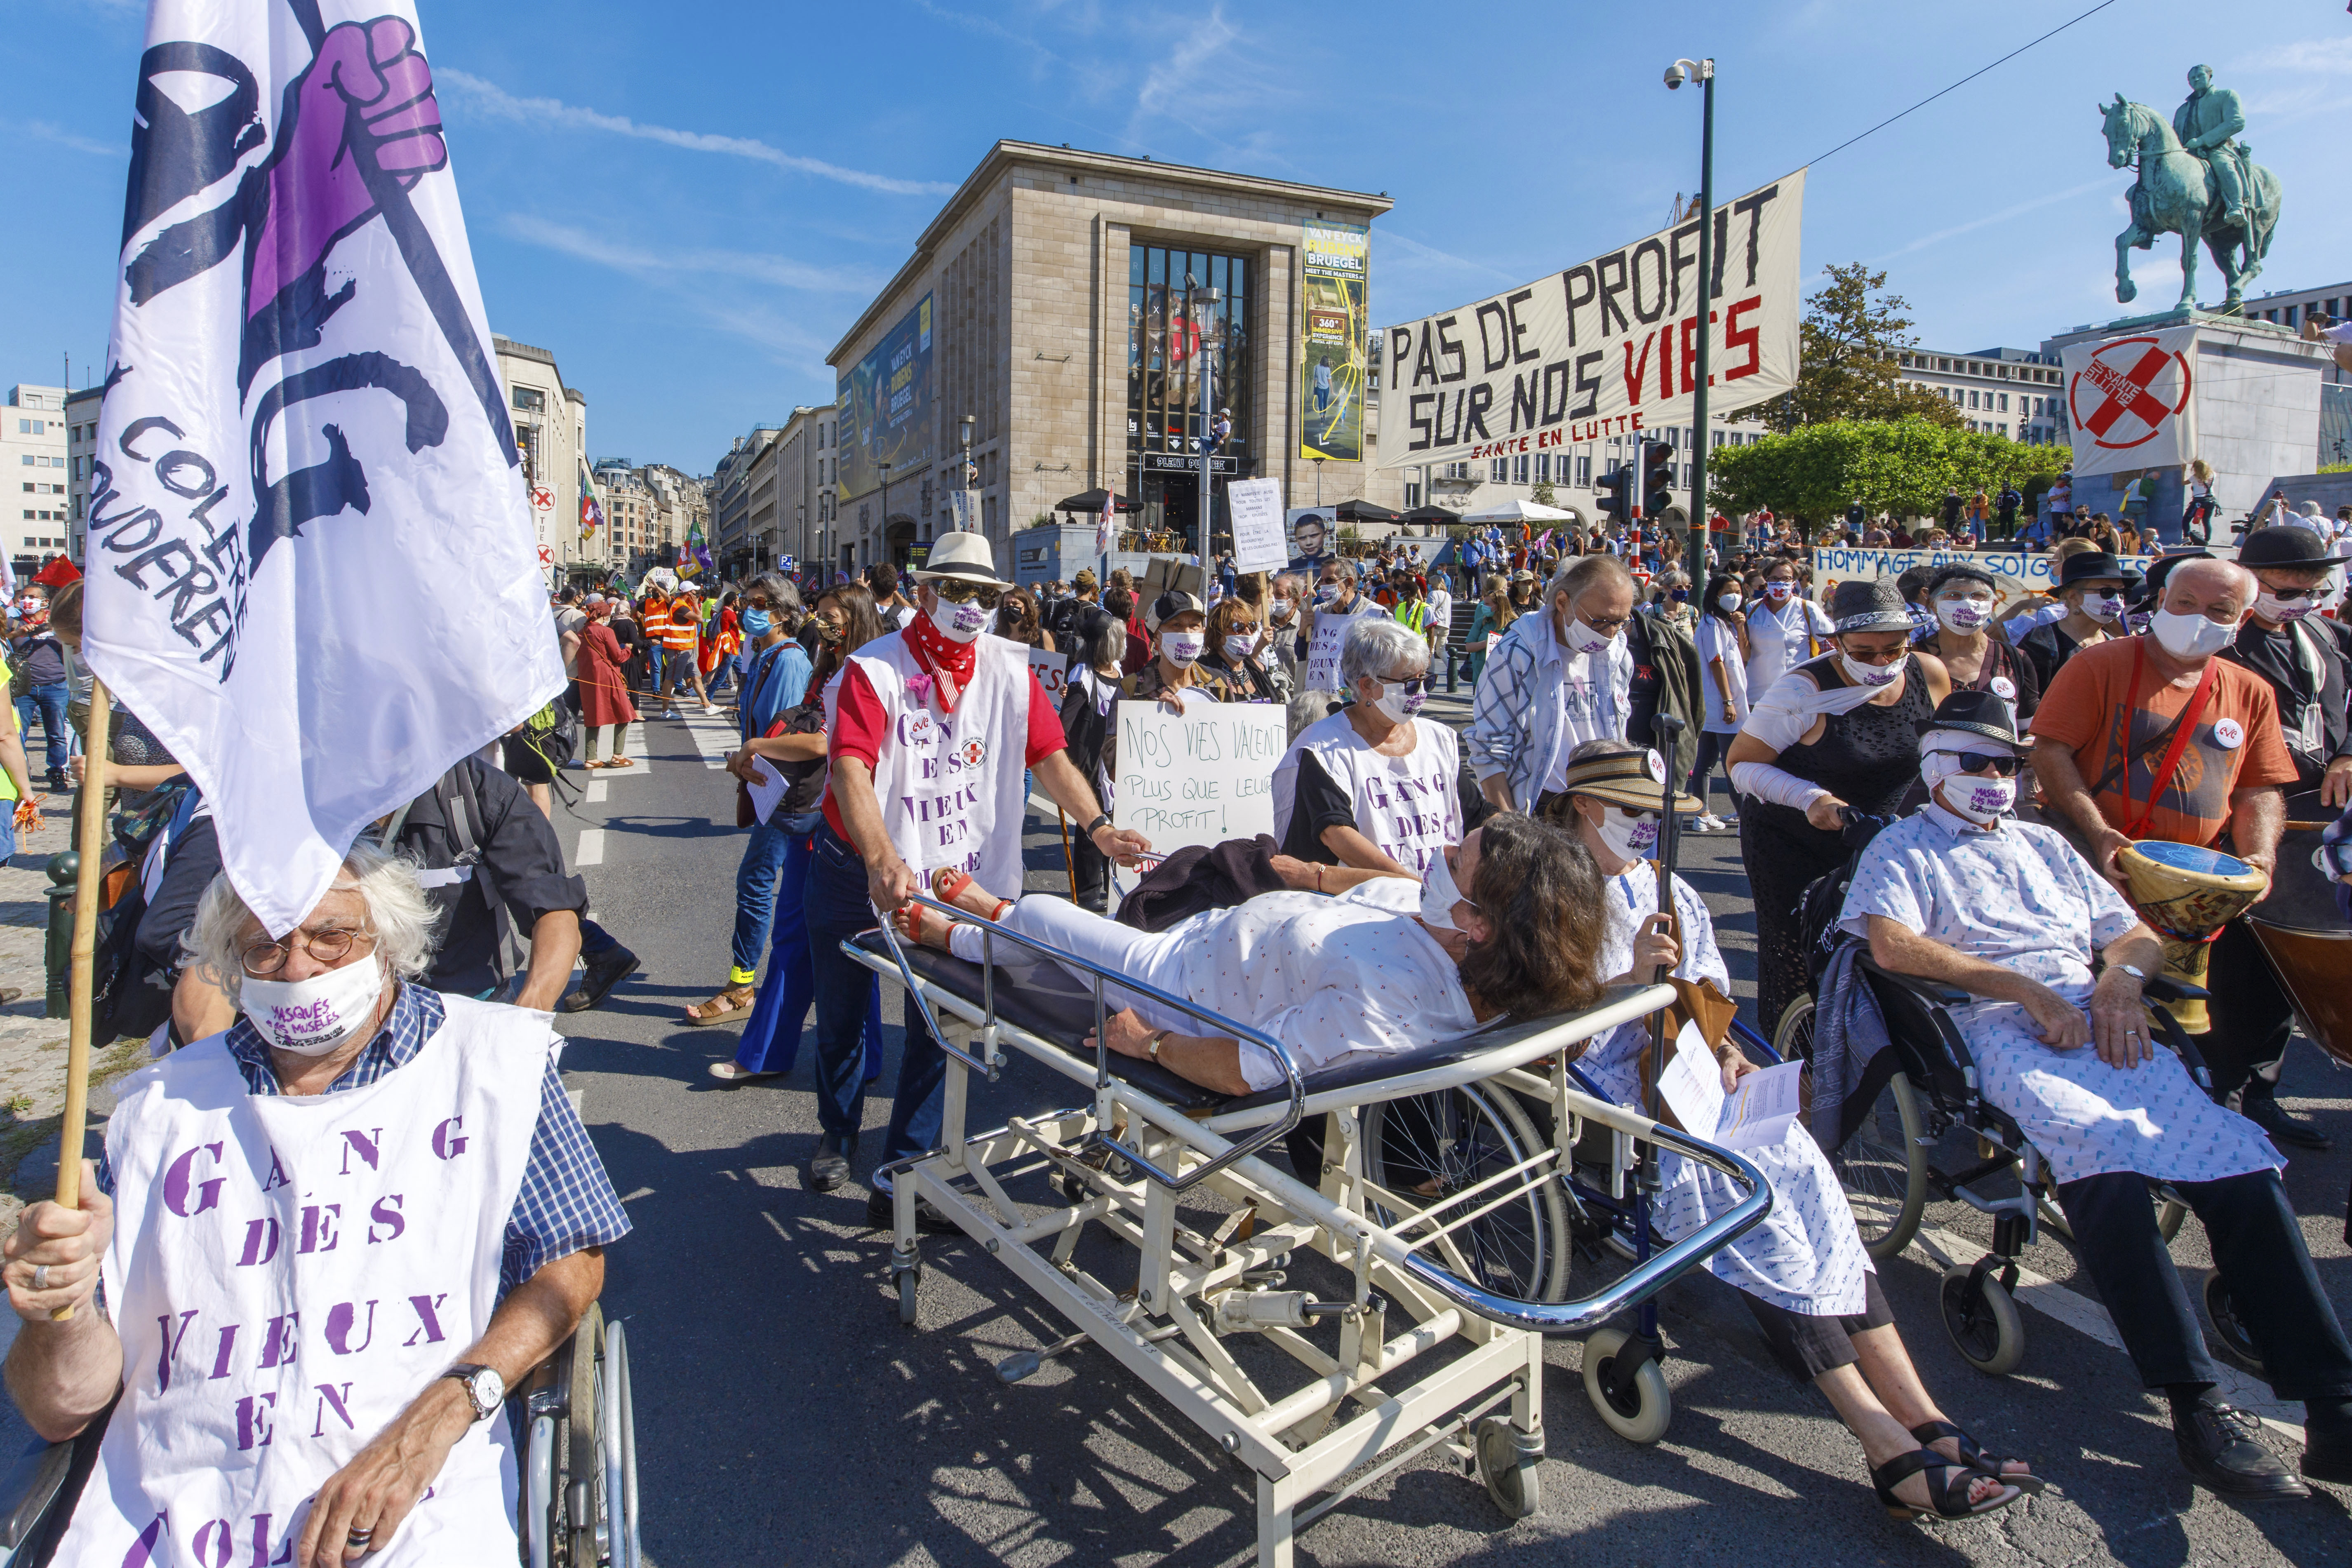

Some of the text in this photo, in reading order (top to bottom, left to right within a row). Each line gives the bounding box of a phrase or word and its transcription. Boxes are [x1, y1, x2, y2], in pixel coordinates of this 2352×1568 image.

[1309, 228, 1362, 243] VAN EYCK
[1309, 240, 1361, 257] RUBENS
[1308, 253, 1362, 270] BRUEGEL
[1391, 184, 1778, 390] PAS DE PROFIT
[1319, 318, 1338, 328] 360°
[891, 341, 912, 372] VAN EYCK
[1132, 343, 1180, 355] BAR
[891, 364, 912, 395] RUBENS
[1409, 294, 1761, 450] SUR NOS VIES
[891, 384, 912, 415] BRUEGEL
[1471, 412, 1644, 459] SANTE EN LUTTE
[1157, 457, 1225, 470] PLEIN PUIEK
[119, 416, 247, 635] COLERE
[781, 556, 788, 565] P
[1818, 550, 1922, 574] HOMMAGE
[1985, 552, 2147, 578] SOIGTS
[955, 612, 966, 621] PAS
[1310, 641, 1328, 651] DES
[1309, 671, 1324, 680] EN
[1126, 717, 1171, 768] NOS
[1233, 720, 1286, 761] VALENT
[1124, 775, 1172, 801] PLUS
[1183, 778, 1221, 799] QUE
[1366, 773, 1445, 809] GANG
[1971, 795, 1985, 805] PAS
[940, 816, 968, 846] EN
[1396, 812, 1440, 838] DES
[1632, 830, 1645, 839] PAS
[272, 998, 329, 1023] MASQUÉS
[292, 1011, 340, 1034] MUSELÉS
[275, 1037, 305, 1046] GANG
[163, 1117, 470, 1218] GANG
[158, 1293, 448, 1396] VIEUX
[236, 1382, 354, 1451] EN
